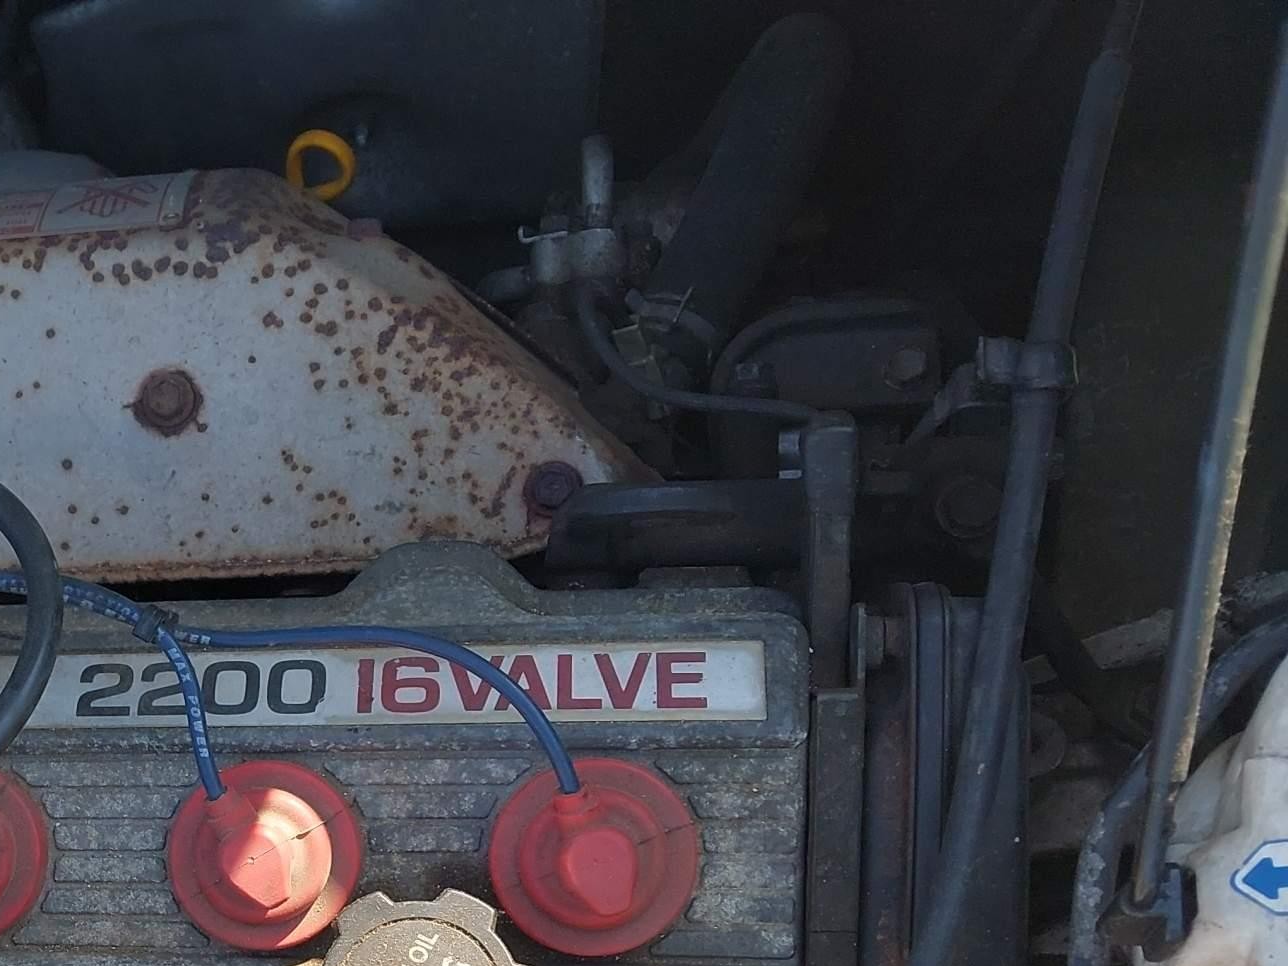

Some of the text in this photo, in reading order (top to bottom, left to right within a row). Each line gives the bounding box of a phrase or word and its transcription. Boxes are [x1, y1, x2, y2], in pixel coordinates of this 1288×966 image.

[76, 659, 325, 717] 2200
[188, 695, 210, 758] POWER
[408, 932, 440, 964] OIL
